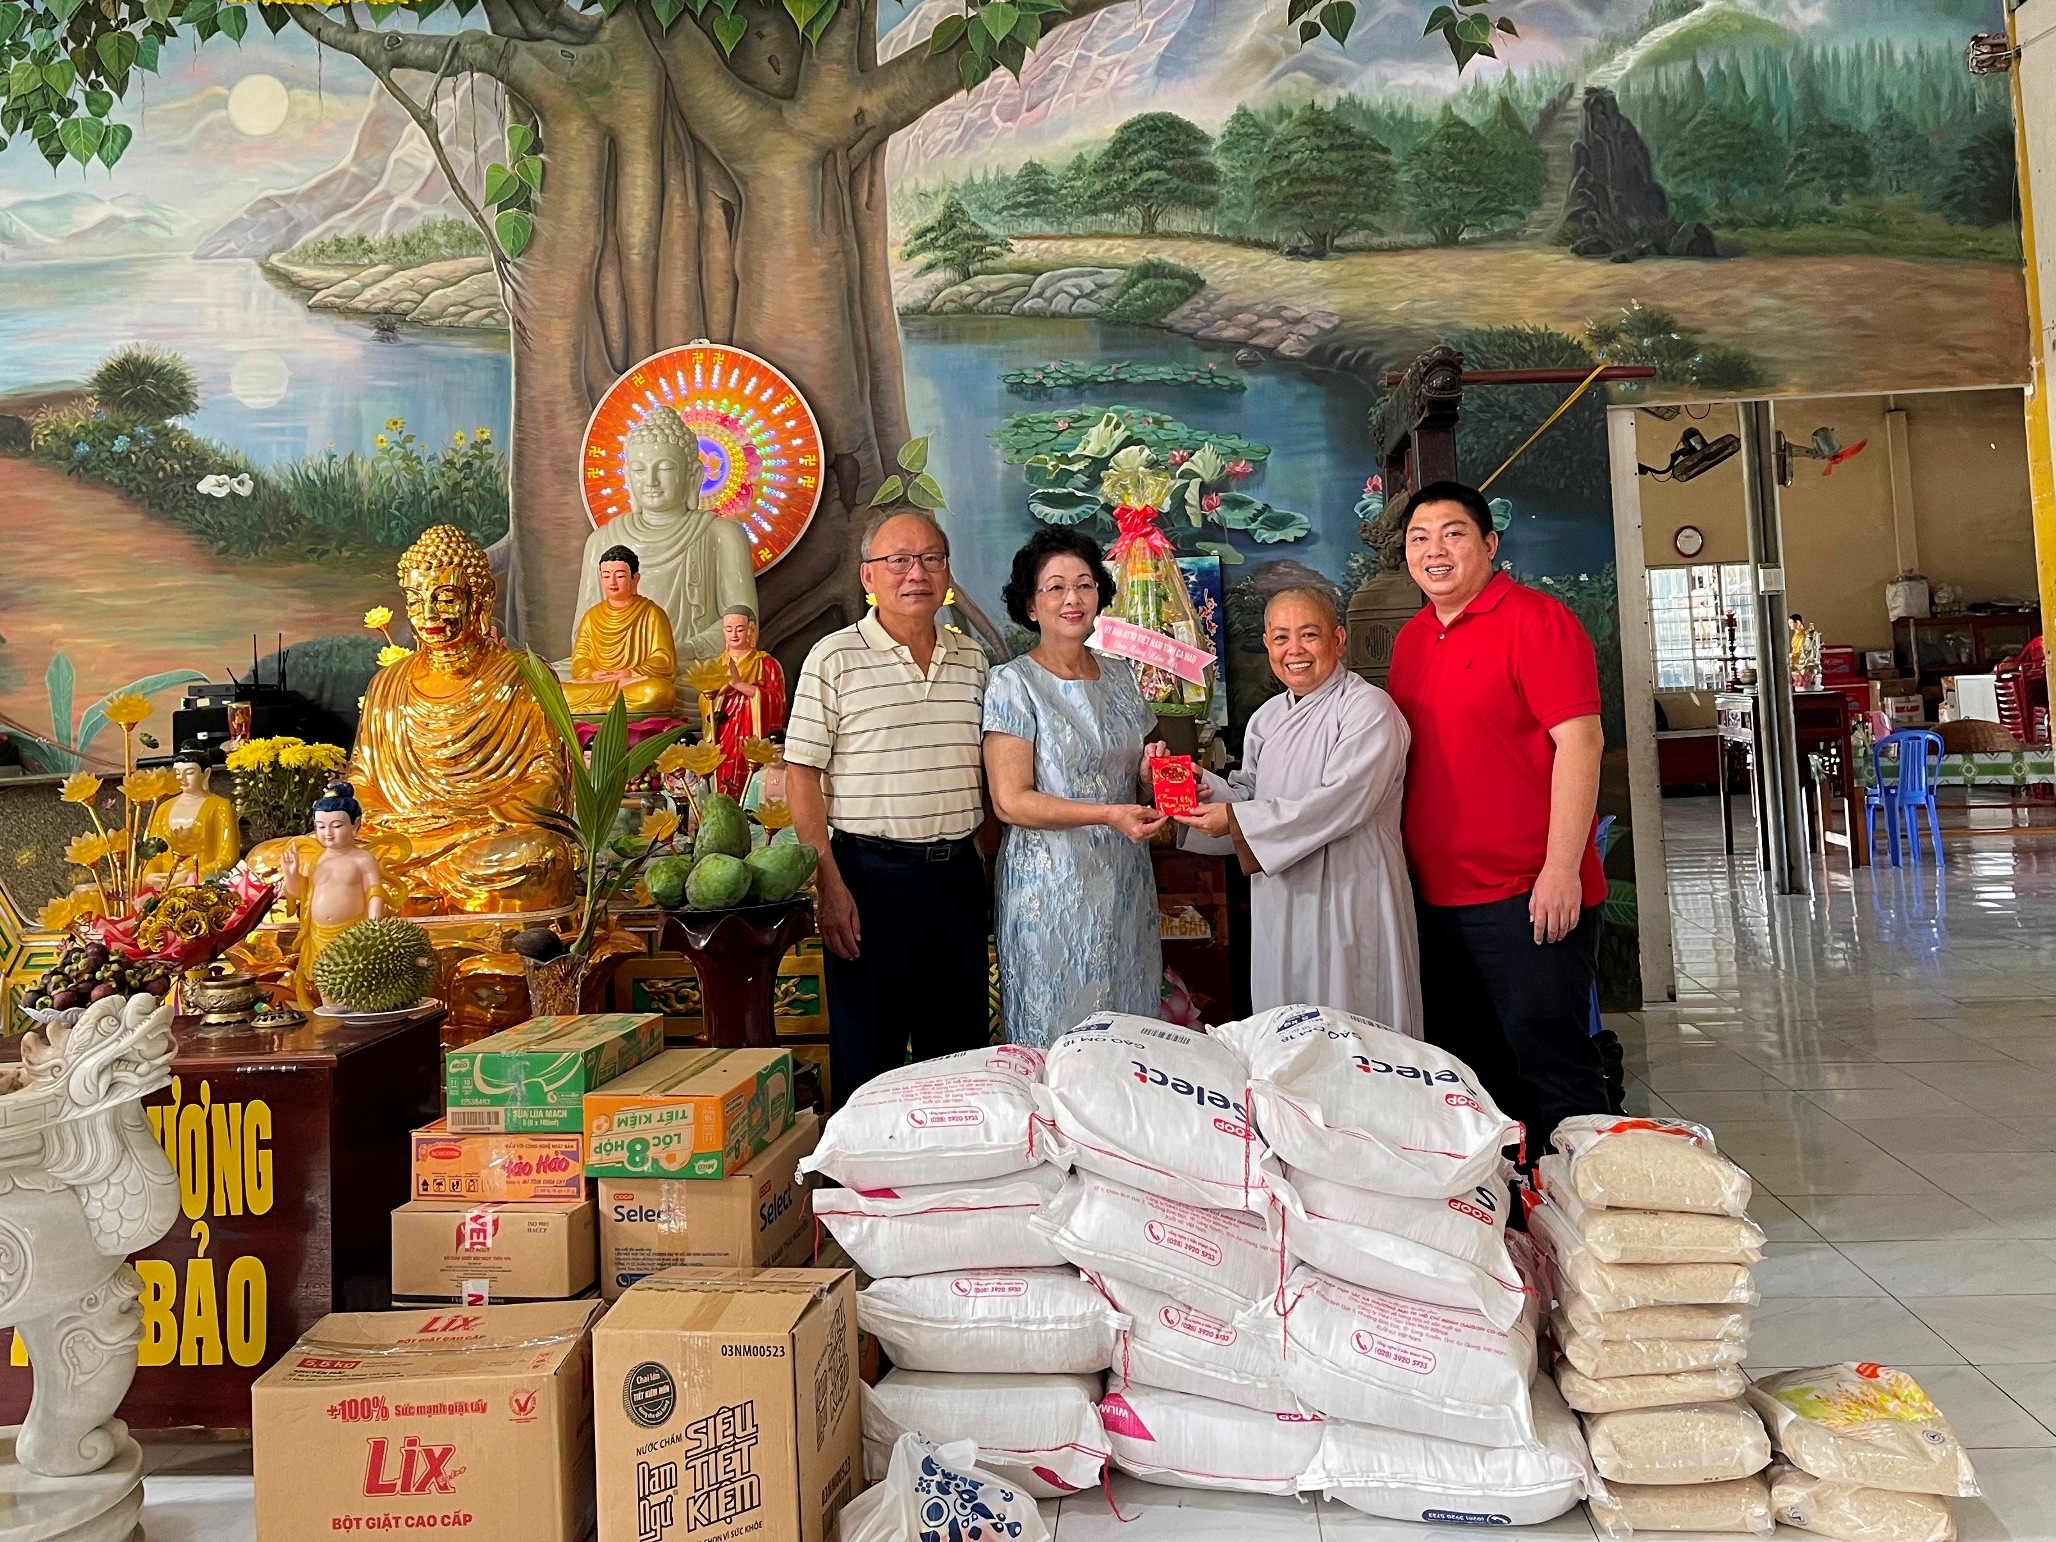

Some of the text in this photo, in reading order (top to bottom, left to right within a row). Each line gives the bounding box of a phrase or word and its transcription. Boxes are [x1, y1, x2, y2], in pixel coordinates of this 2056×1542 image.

[1131, 1060, 1248, 1123] Select
[618, 1109, 688, 1128] TIẾT KIỆM
[536, 1150, 570, 1174] Hảo
[593, 1132, 682, 1169] LỐC 8 HỘP
[760, 1181, 792, 1232] Select
[1449, 1199, 1493, 1225] COOP
[136, 1220, 267, 1367] BẢO
[416, 1314, 483, 1334] Lix
[721, 1344, 785, 1358] 03NM00523
[1375, 1347, 1428, 1370] (028) 3920 5733
[327, 1395, 390, 1422] +100%
[395, 1402, 415, 1416] Sức
[416, 1403, 448, 1418] mạnh
[448, 1401, 470, 1416] giặt
[636, 1432, 683, 1457] NƯỚC CHẤM
[685, 1400, 759, 1460] SIÊU
[363, 1435, 456, 1497] Lix
[637, 1460, 678, 1499] Nam
[685, 1436, 758, 1493] TIẾT
[638, 1493, 674, 1542] Ngư
[686, 1473, 761, 1533] KIỆM
[332, 1510, 473, 1533] BỘT GIẶT CAO CẤP
[730, 1527, 744, 1539] SỨC
